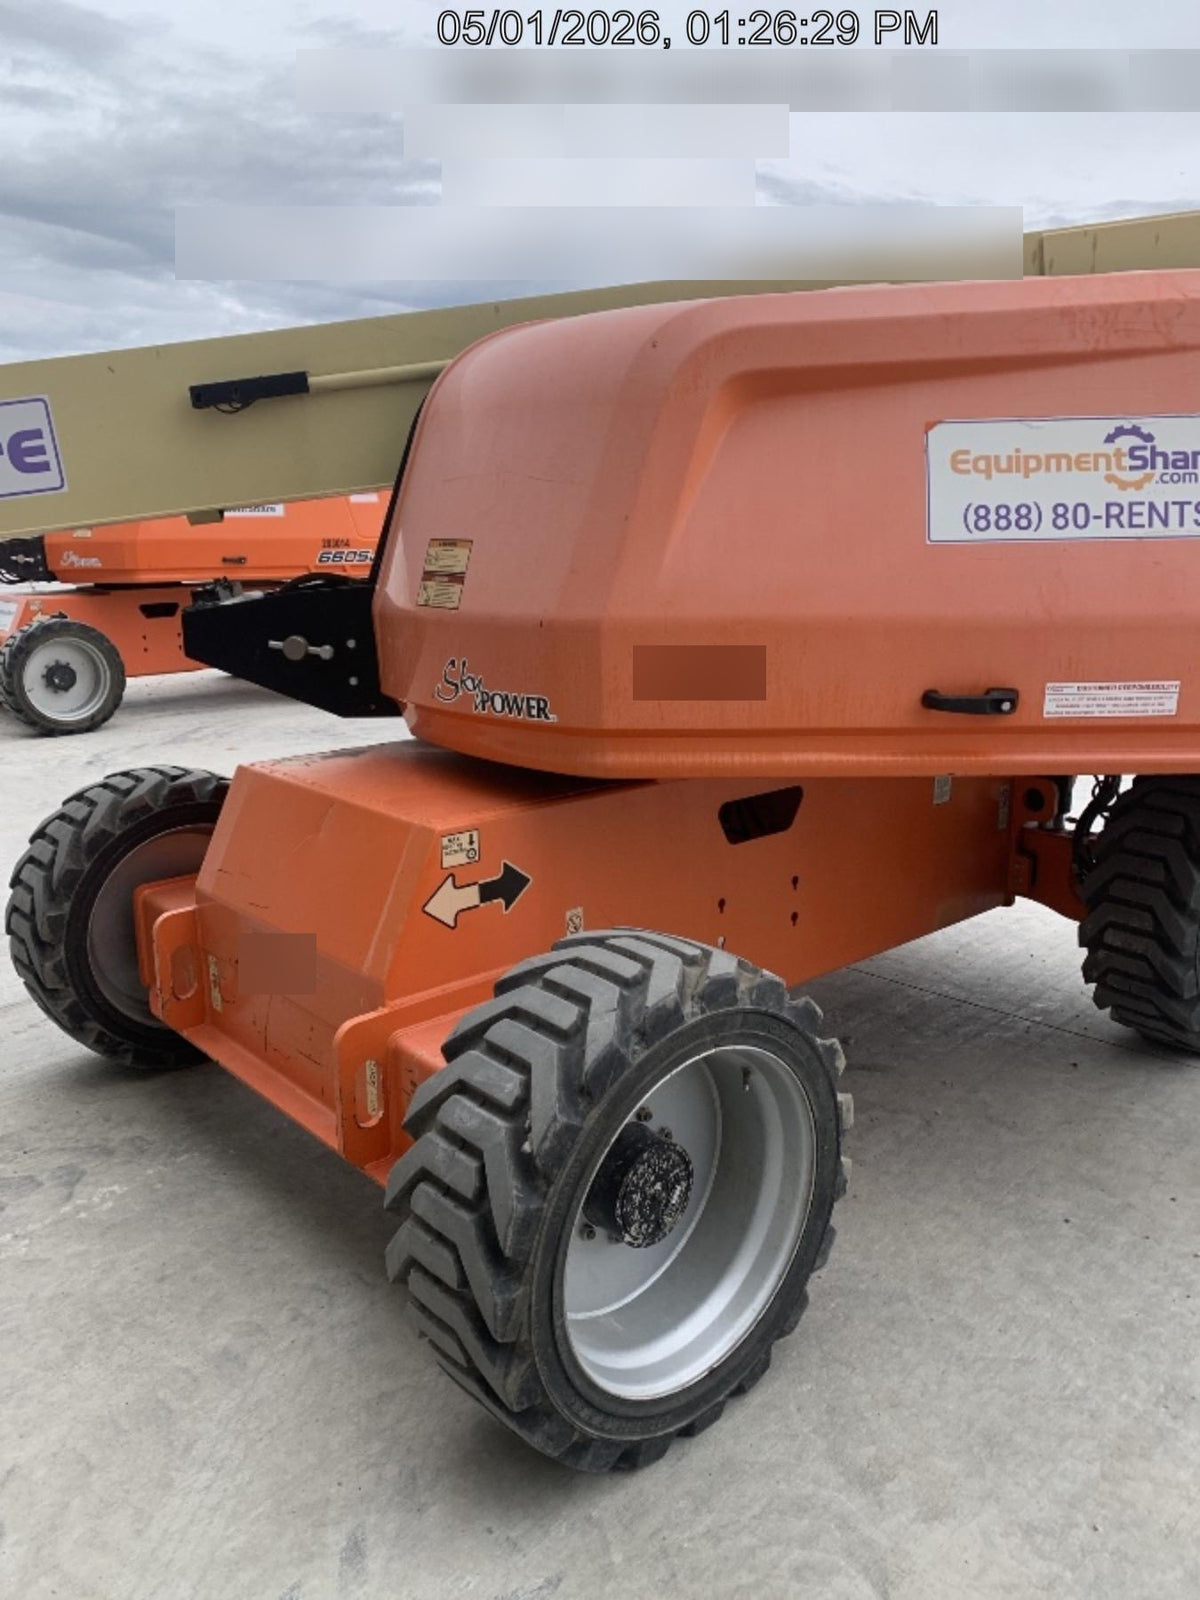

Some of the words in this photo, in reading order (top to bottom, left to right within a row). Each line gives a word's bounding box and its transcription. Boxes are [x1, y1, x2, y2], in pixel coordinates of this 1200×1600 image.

[0, 428, 51, 473] E
[1155, 472, 1198, 485] .com
[963, 502, 1042, 533] (888)
[435, 657, 483, 712] Sky
[479, 690, 552, 721] POWER
